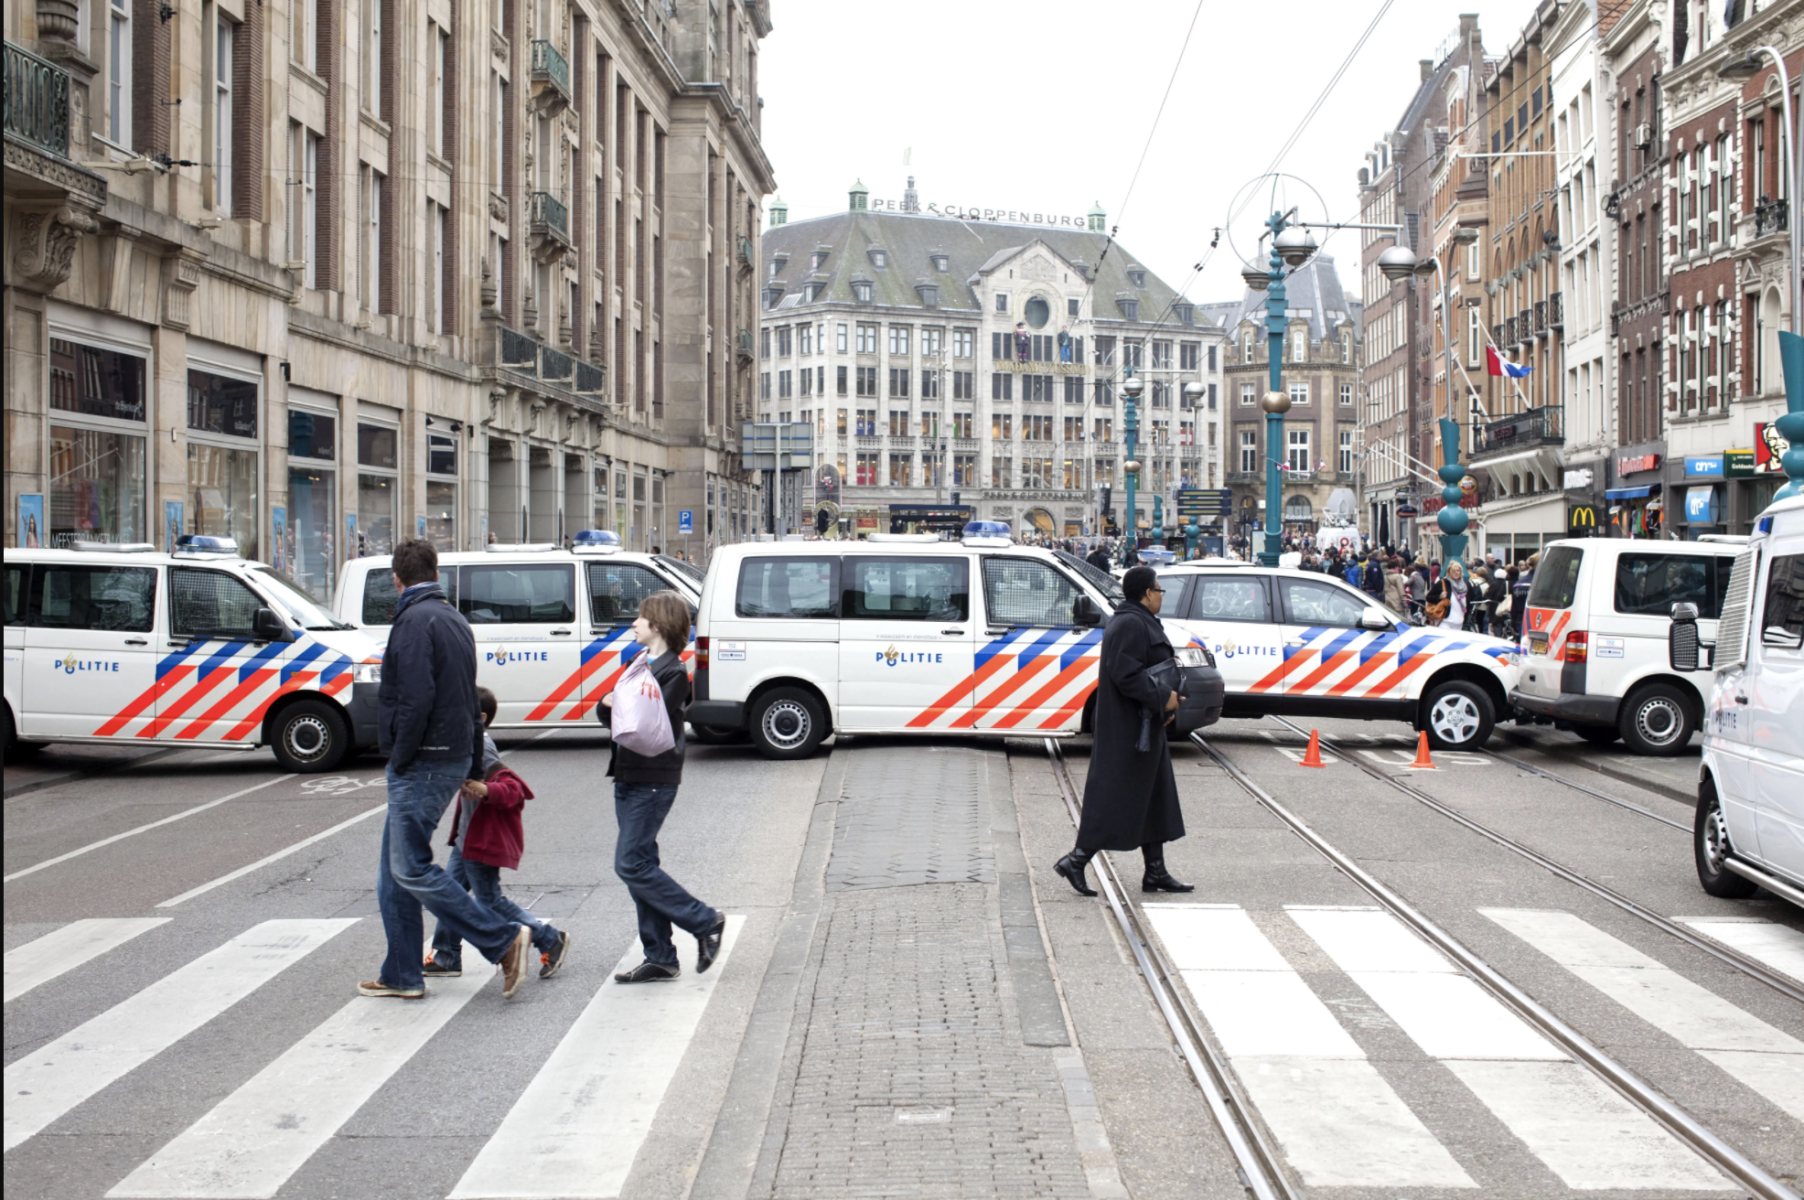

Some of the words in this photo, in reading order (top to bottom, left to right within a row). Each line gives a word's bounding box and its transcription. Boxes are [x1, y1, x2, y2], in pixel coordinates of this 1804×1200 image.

[873, 198, 922, 212] PEEK
[927, 202, 940, 214] &
[944, 205, 1086, 228] CLOPPENBURG
[996, 361, 1043, 373] MADAME
[681, 512, 690, 523] P
[486, 651, 548, 666] POLITIE
[876, 651, 943, 667] POLITIE
[1215, 644, 1277, 659] POLITIE
[54, 659, 119, 675] POLITIE
